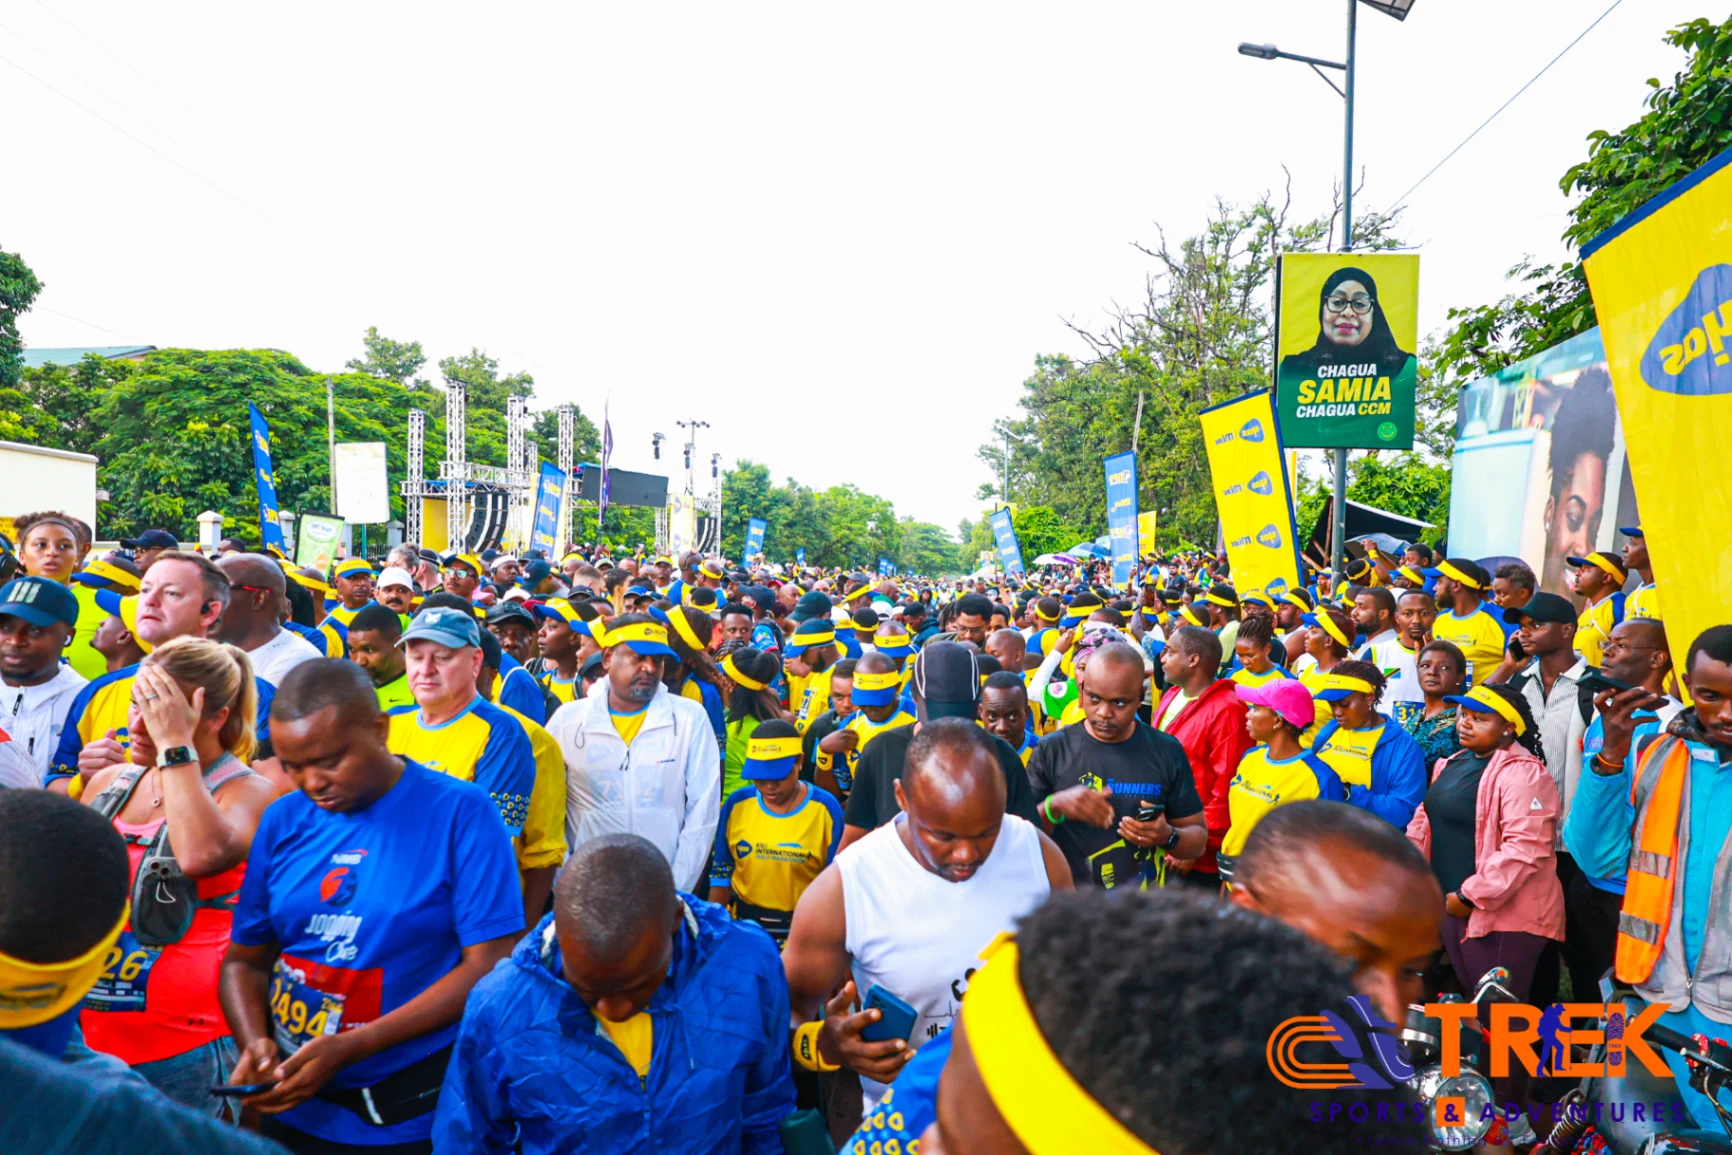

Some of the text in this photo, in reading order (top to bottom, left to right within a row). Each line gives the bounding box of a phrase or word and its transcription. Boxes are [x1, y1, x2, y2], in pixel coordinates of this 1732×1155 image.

[1317, 364, 1377, 378] CHAGUA
[1297, 376, 1391, 404] SAMIA
[1296, 402, 1391, 418] CHAGUA CCM
